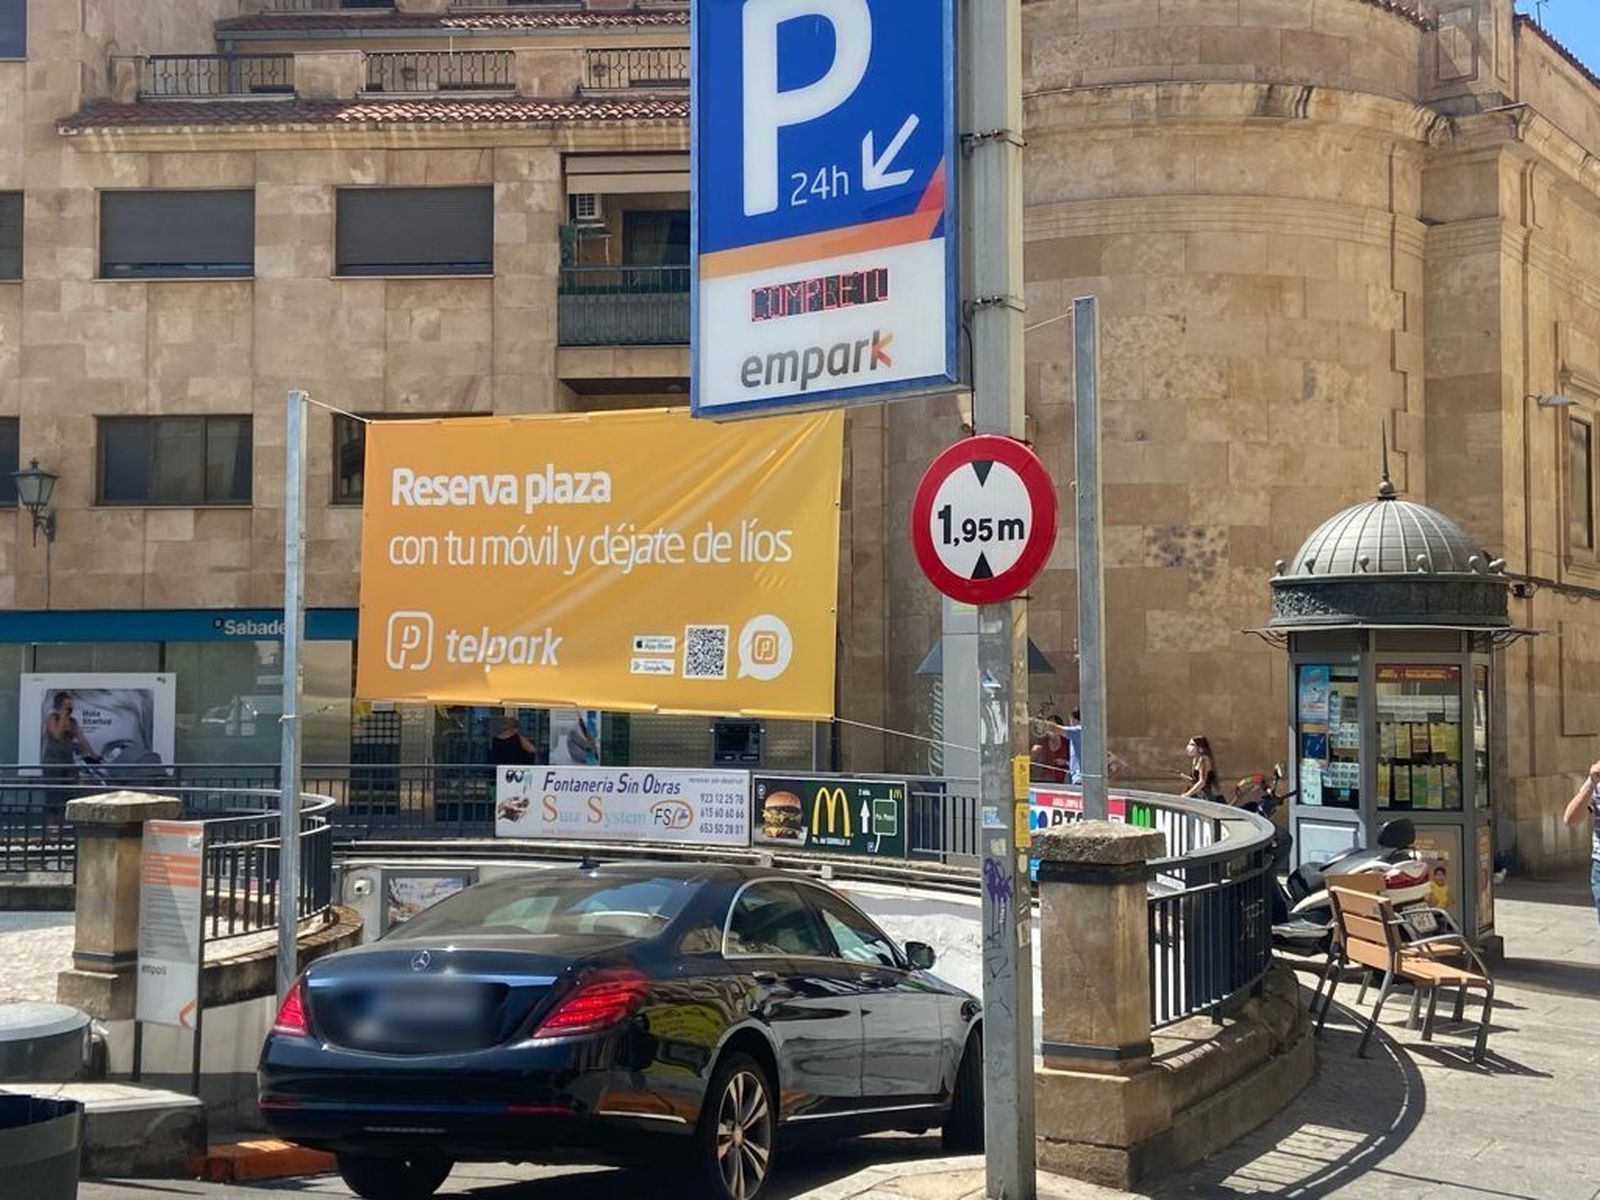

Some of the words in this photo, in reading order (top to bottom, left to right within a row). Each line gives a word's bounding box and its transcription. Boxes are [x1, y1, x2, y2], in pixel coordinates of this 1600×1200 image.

[743, 0, 872, 217] P
[791, 165, 849, 206] 24h
[741, 330, 893, 391] empark
[391, 467, 519, 507] Reserva
[525, 463, 611, 514] plaza
[389, 535, 438, 565] con
[444, 530, 475, 565] tu
[481, 524, 558, 566] móvil
[563, 535, 585, 575] y
[589, 522, 685, 575] déjate
[692, 521, 733, 564] de
[740, 518, 793, 563] líos
[998, 517, 1025, 541] m
[445, 626, 563, 673] telpark
[616, 773, 639, 794] Sin
[643, 773, 681, 795] Obras
